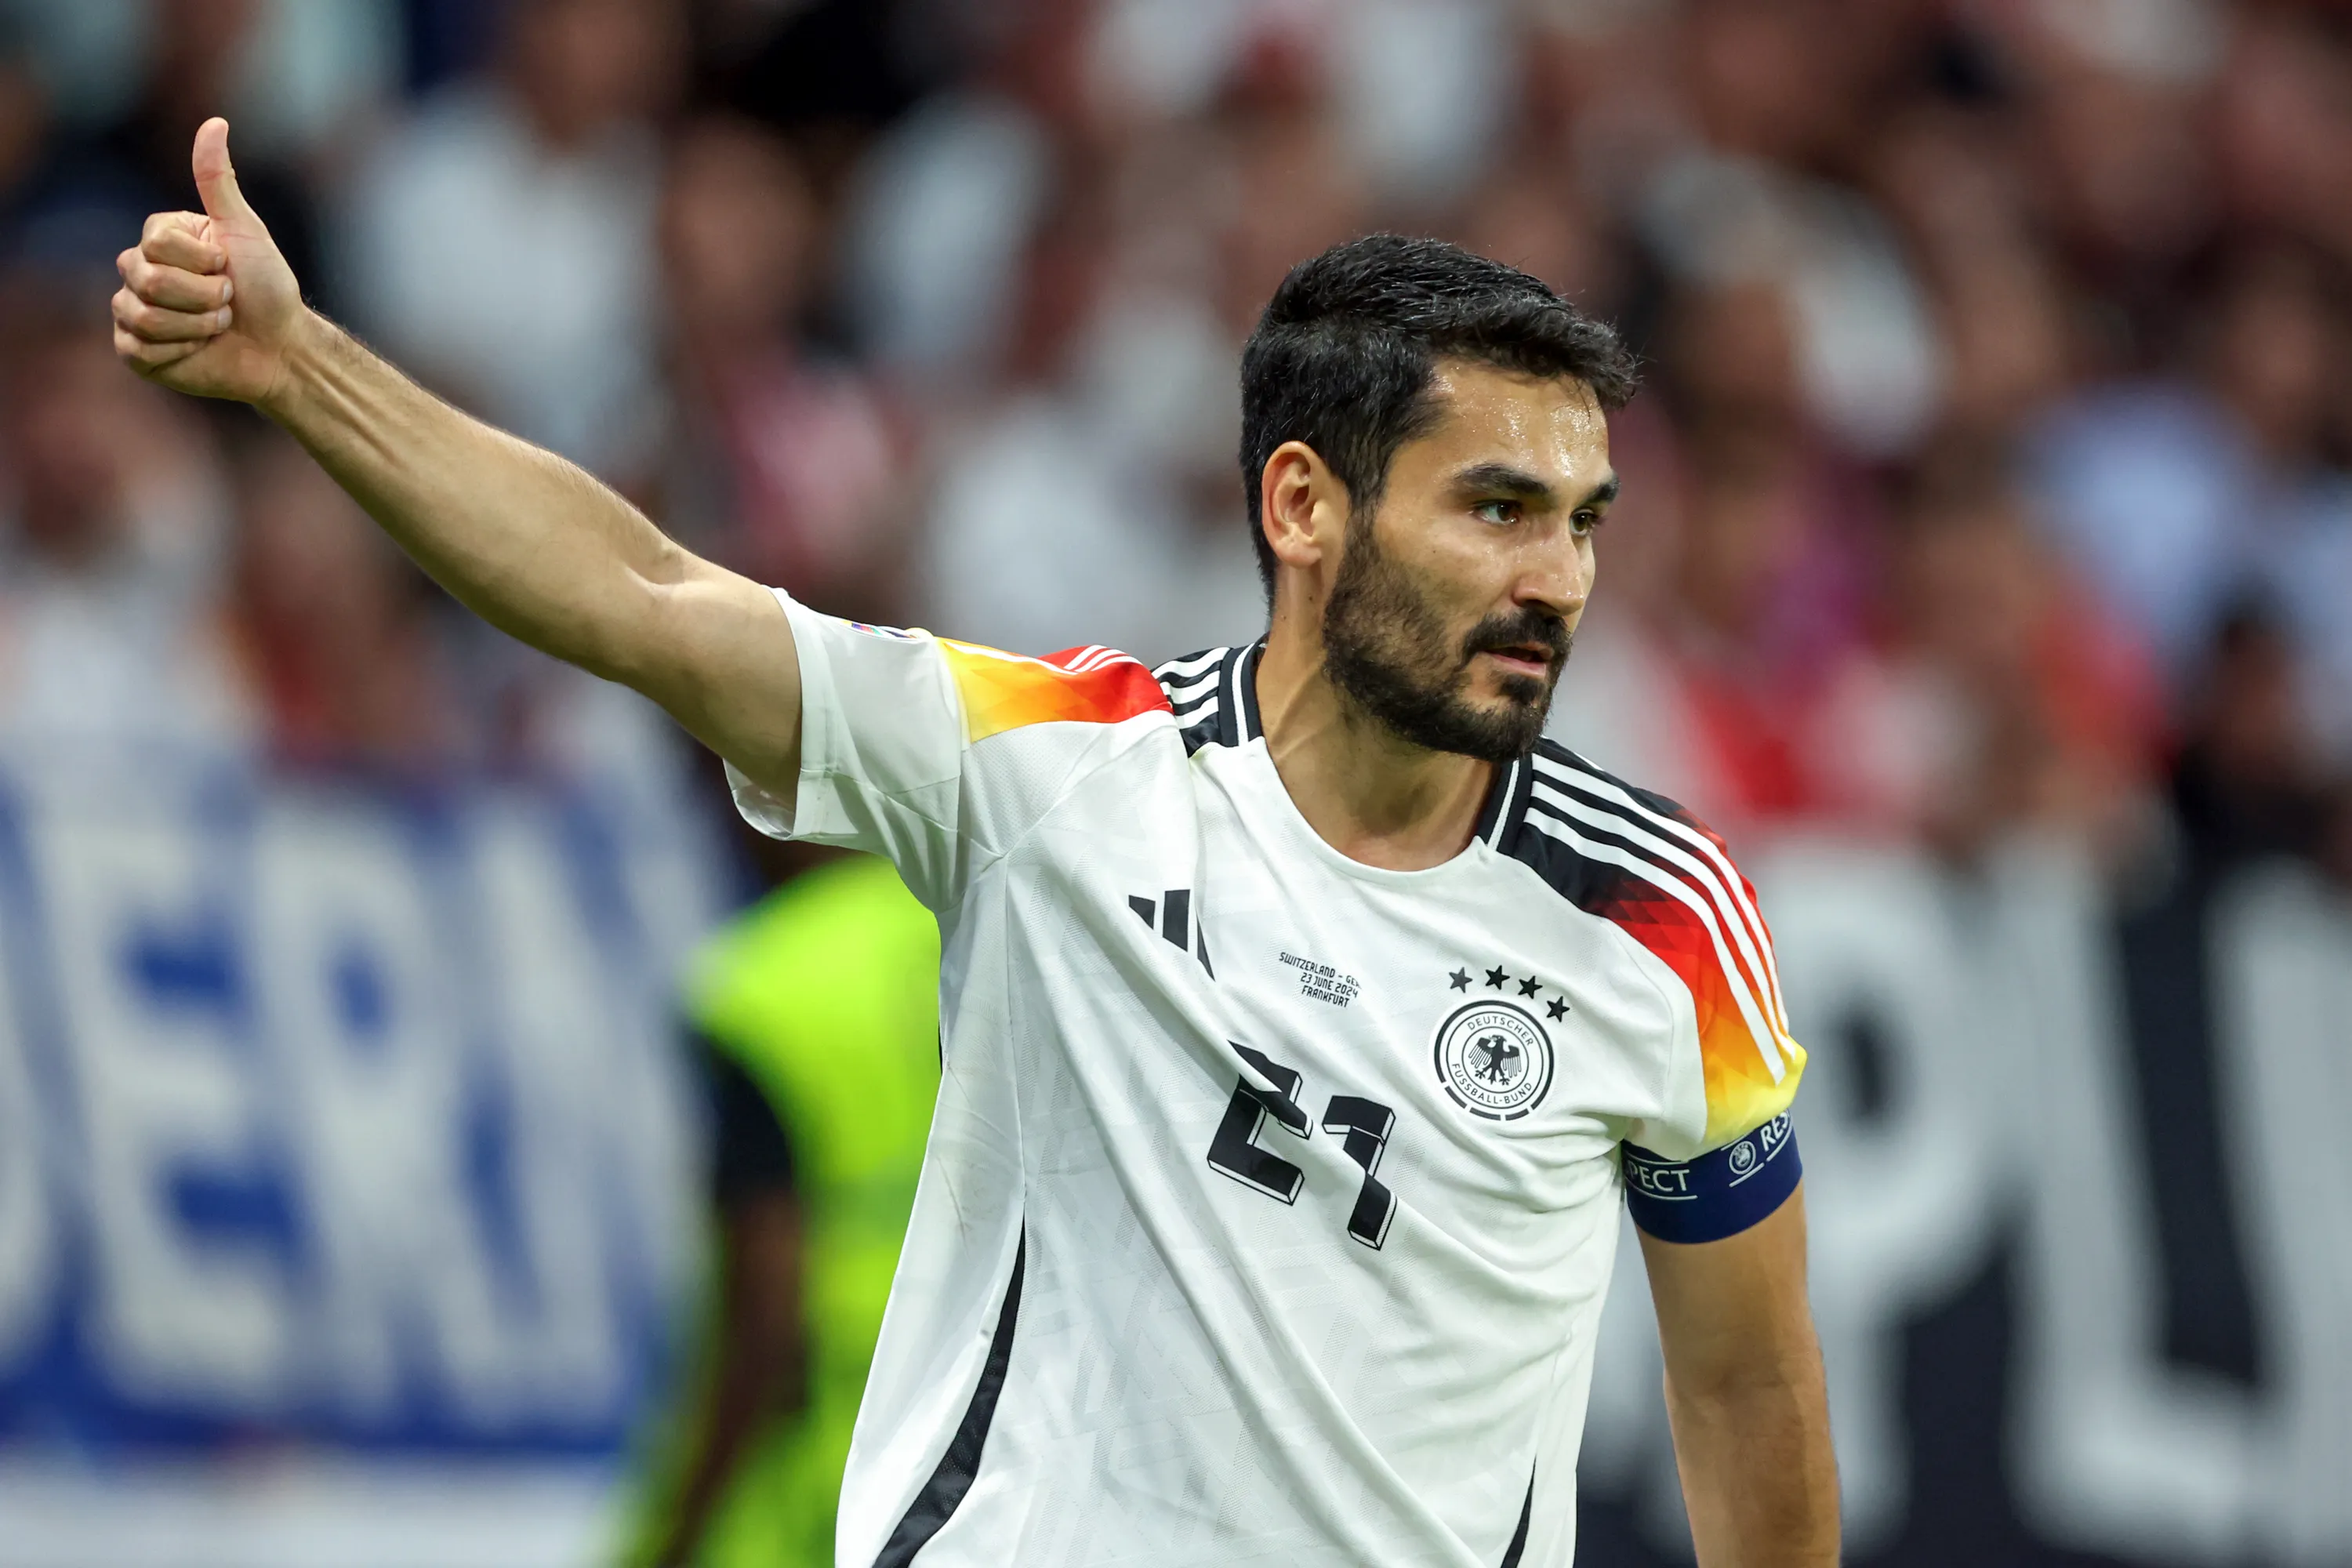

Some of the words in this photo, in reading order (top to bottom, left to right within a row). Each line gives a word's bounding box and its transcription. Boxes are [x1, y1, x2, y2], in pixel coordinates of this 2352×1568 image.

[1279, 952, 1335, 978] SWITZERLAND
[1301, 972, 1312, 983] 23
[1313, 976, 1334, 990] JUNE
[1334, 982, 1359, 998] 2024
[1301, 985, 1349, 1007] FRANKFURT
[1467, 1015, 1534, 1046] DEUTSCHER
[1451, 1062, 1533, 1105] FUSSBALL-BUND
[1207, 1039, 1398, 1251] 21
